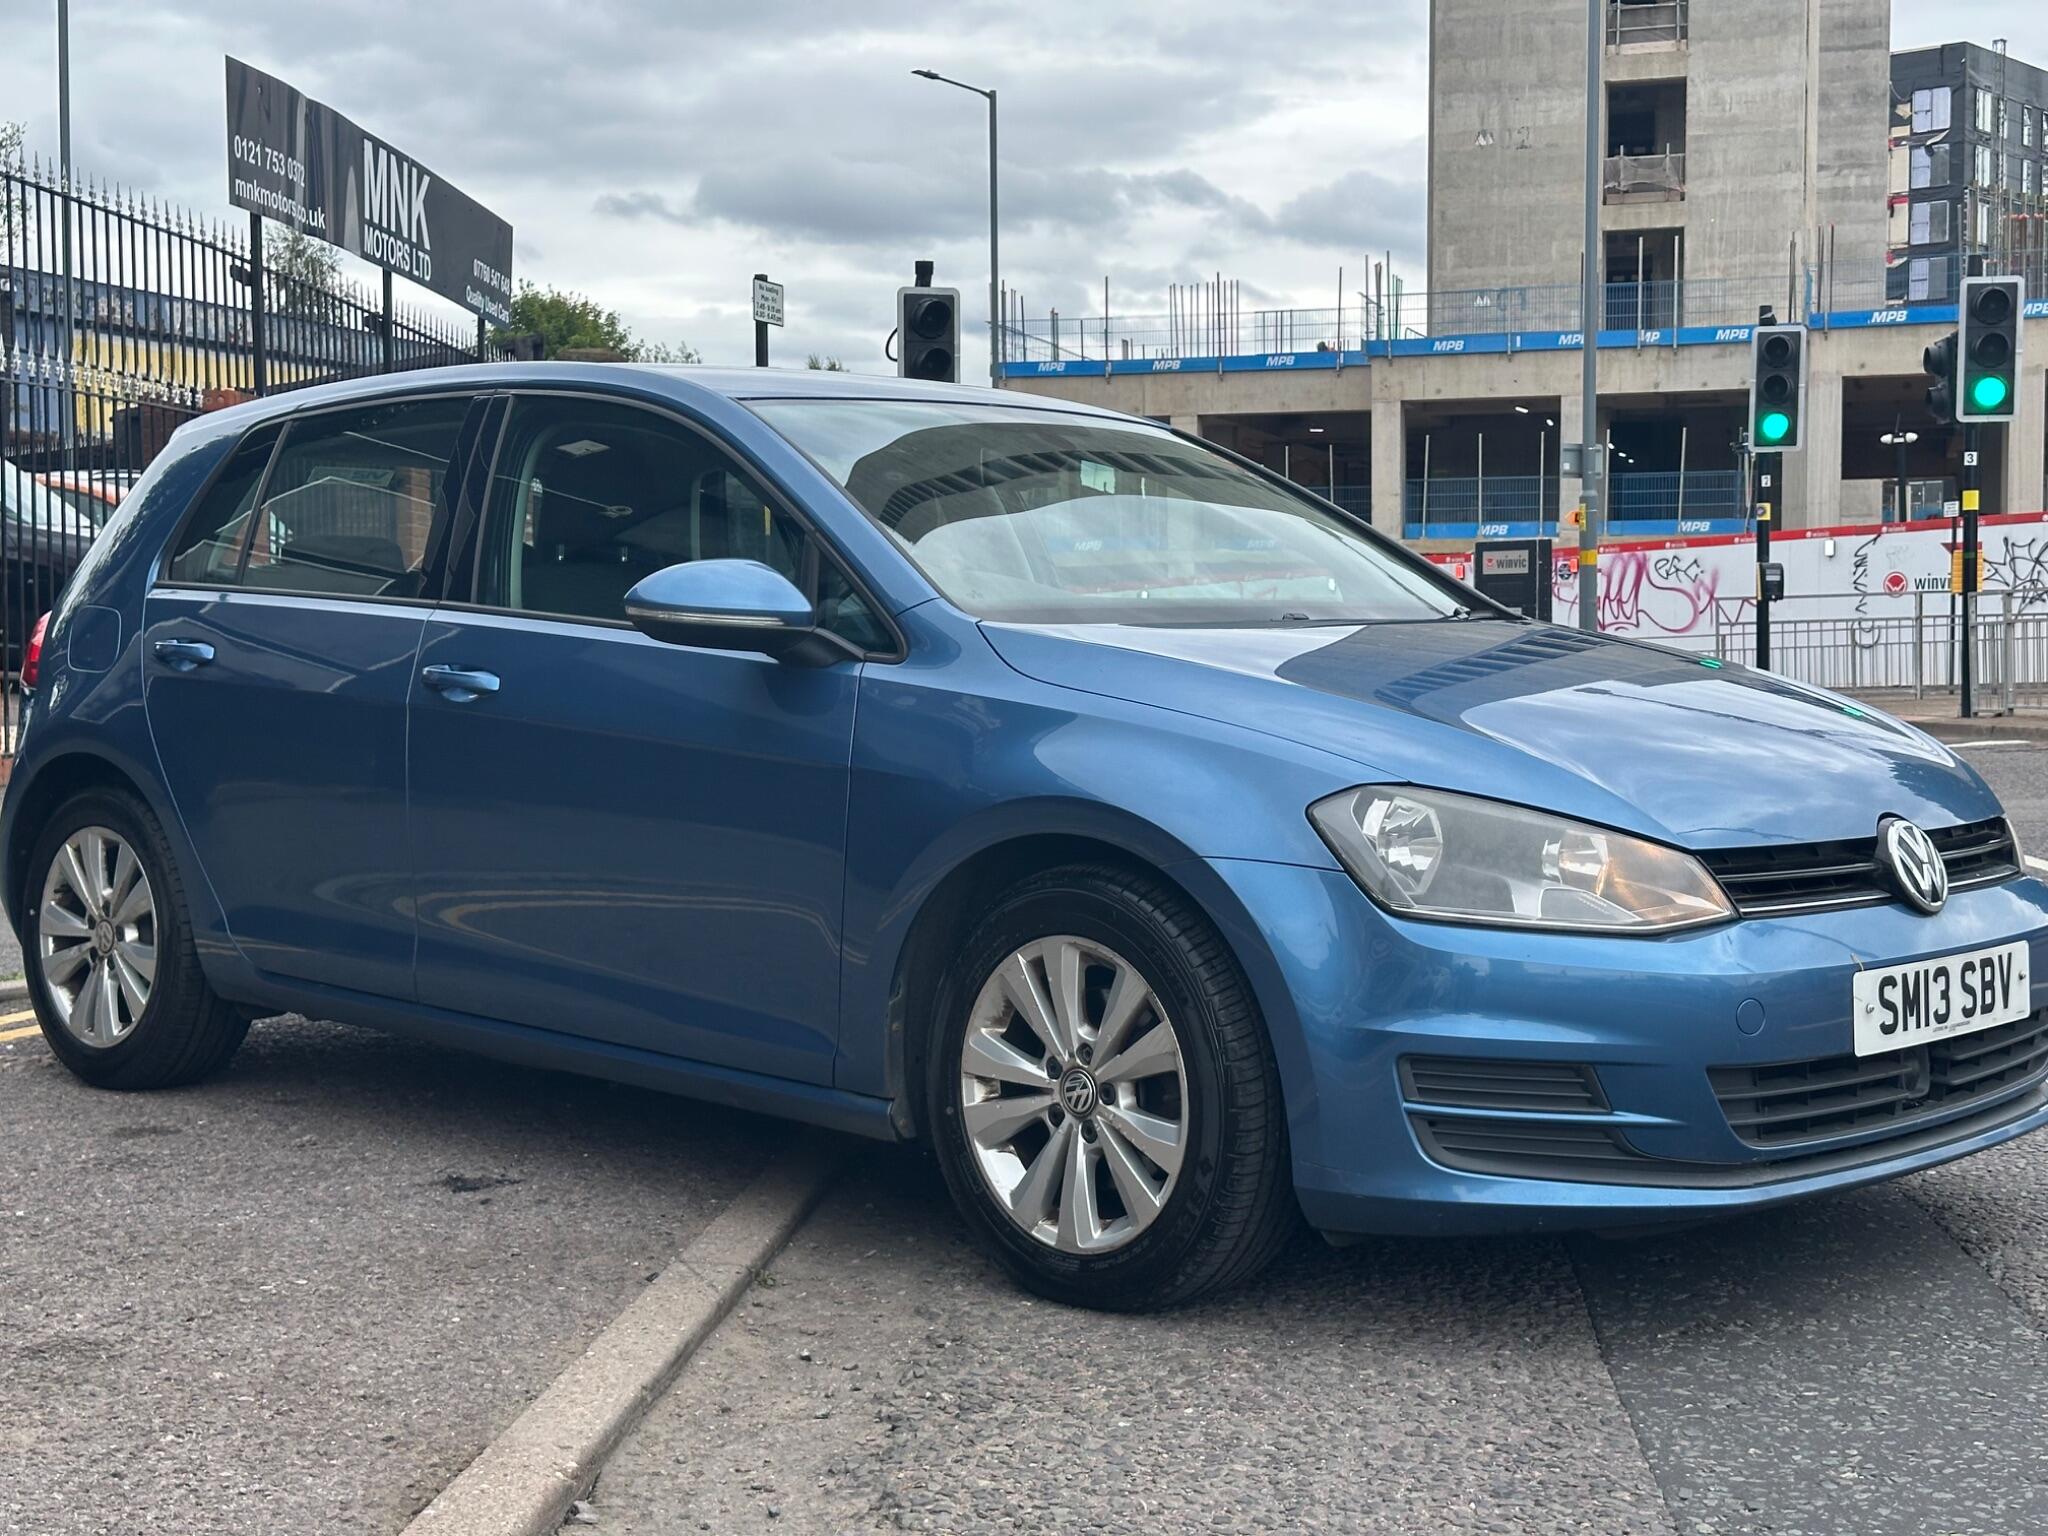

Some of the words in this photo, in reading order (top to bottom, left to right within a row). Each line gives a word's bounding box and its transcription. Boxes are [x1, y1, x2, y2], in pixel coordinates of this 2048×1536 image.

[234, 134, 261, 167] 0121
[265, 147, 285, 176] 753
[363, 138, 431, 251] MNK
[235, 178, 326, 230] mnkmotors.co.uk
[363, 223, 411, 272] MOTORS
[412, 247, 432, 282] LTD
[465, 285, 484, 314] Quality
[485, 295, 498, 317] Used
[498, 303, 509, 323] Cars
[1871, 310, 1908, 323] MPB
[1715, 328, 1749, 341] MPB
[1433, 340, 1464, 351] MPB
[1037, 362, 1066, 372] MPB
[1152, 360, 1181, 370] MPB
[1265, 355, 1296, 367] MPB
[1966, 454, 1974, 463] 3
[1480, 525, 1509, 536] MPB
[1679, 521, 1711, 532] MPB
[1496, 555, 1527, 569] winvic
[1914, 573, 1951, 590] winvi
[1877, 965, 1951, 1036] SM13
[1960, 952, 2013, 1019] SBV
